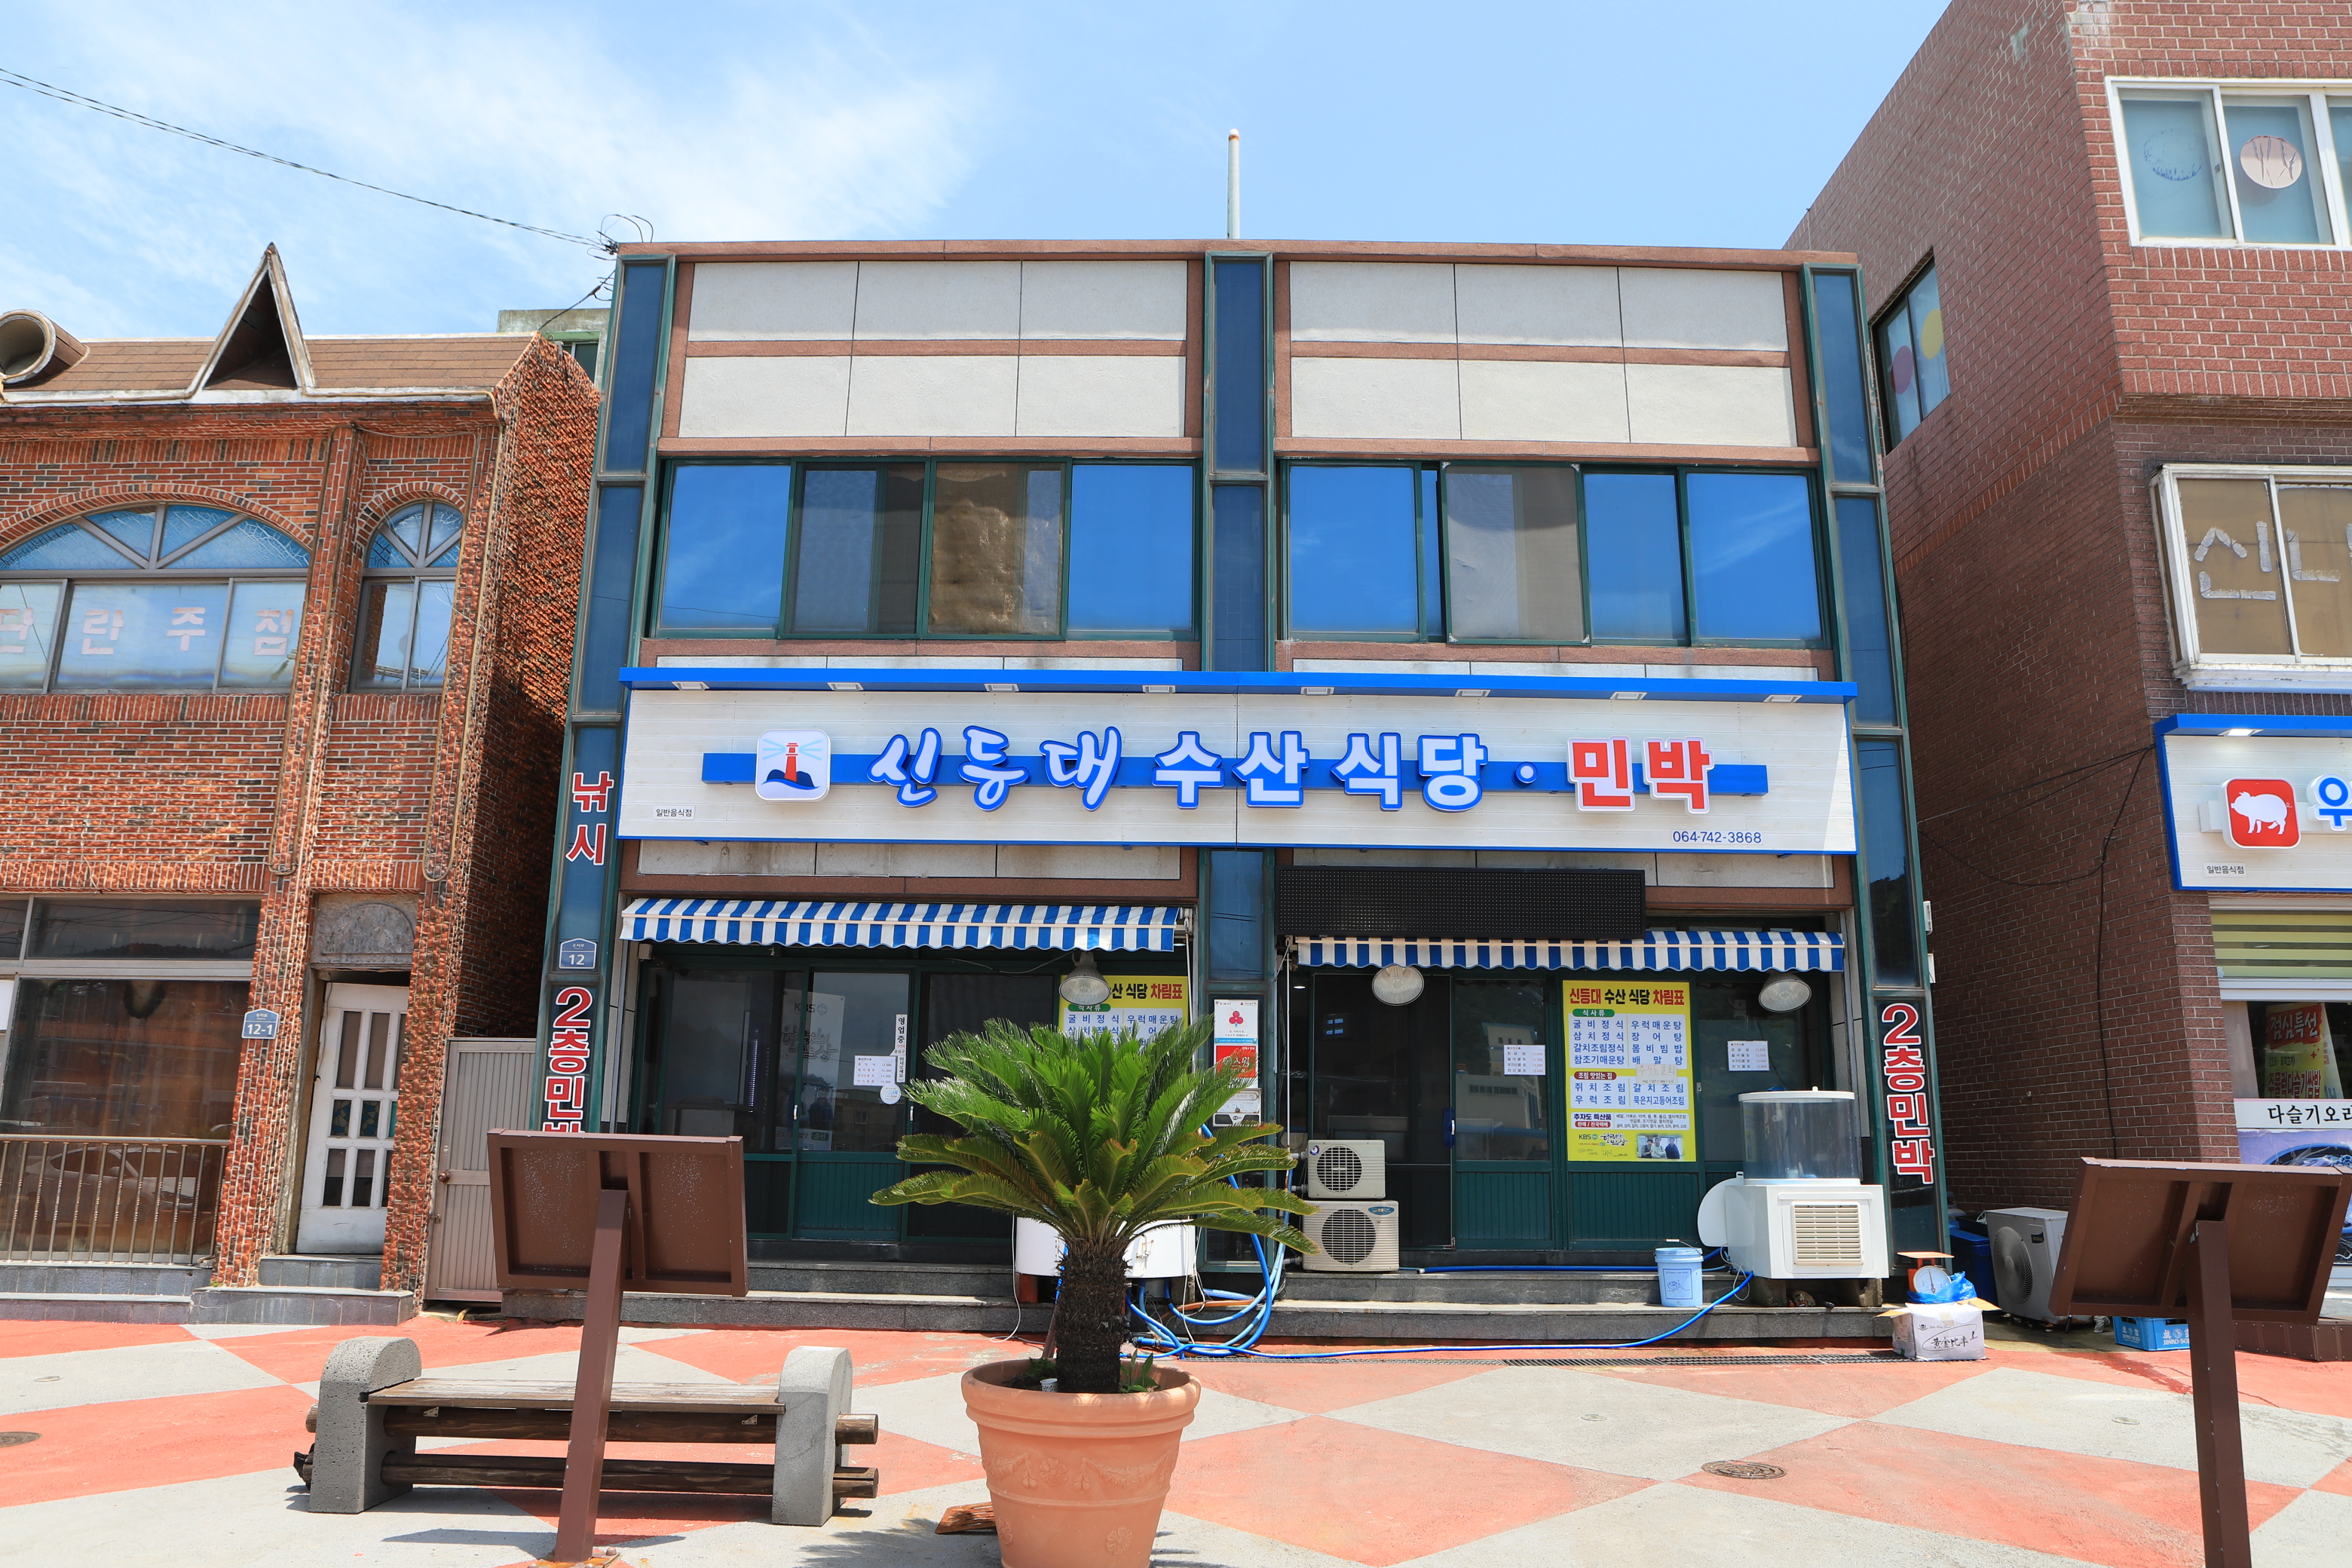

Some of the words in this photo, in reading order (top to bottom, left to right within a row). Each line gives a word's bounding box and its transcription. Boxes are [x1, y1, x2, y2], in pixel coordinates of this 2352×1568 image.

[867, 725, 1122, 811] 신등대
[1566, 736, 1714, 814] 민박
[566, 770, 614, 865] 낚시
[1673, 831, 1762, 843] 064-742-3868
[2207, 865, 2244, 874] 일반음식점
[568, 954, 585, 965] 12
[1110, 983, 1123, 999] 산
[1126, 984, 1147, 999] 식당
[1150, 984, 1182, 999] 차림표
[1570, 988, 1601, 1004] 신등대
[1604, 989, 1626, 1004] 수산
[1628, 989, 1650, 1005] 식당
[1653, 990, 1685, 1005] 차림표
[247, 1024, 273, 1035] 12-1
[897, 1016, 905, 1044] 영업중
[2270, 1011, 2318, 1040] 점심특선
[1573, 1043, 1625, 1053] 갈치조림정식
[542, 986, 593, 1132] 2층민
[1574, 1055, 1625, 1064] 참조기매운탕
[1634, 1096, 1684, 1105] 묵은지고등어조림
[1882, 1003, 1935, 1184] 2층민박
